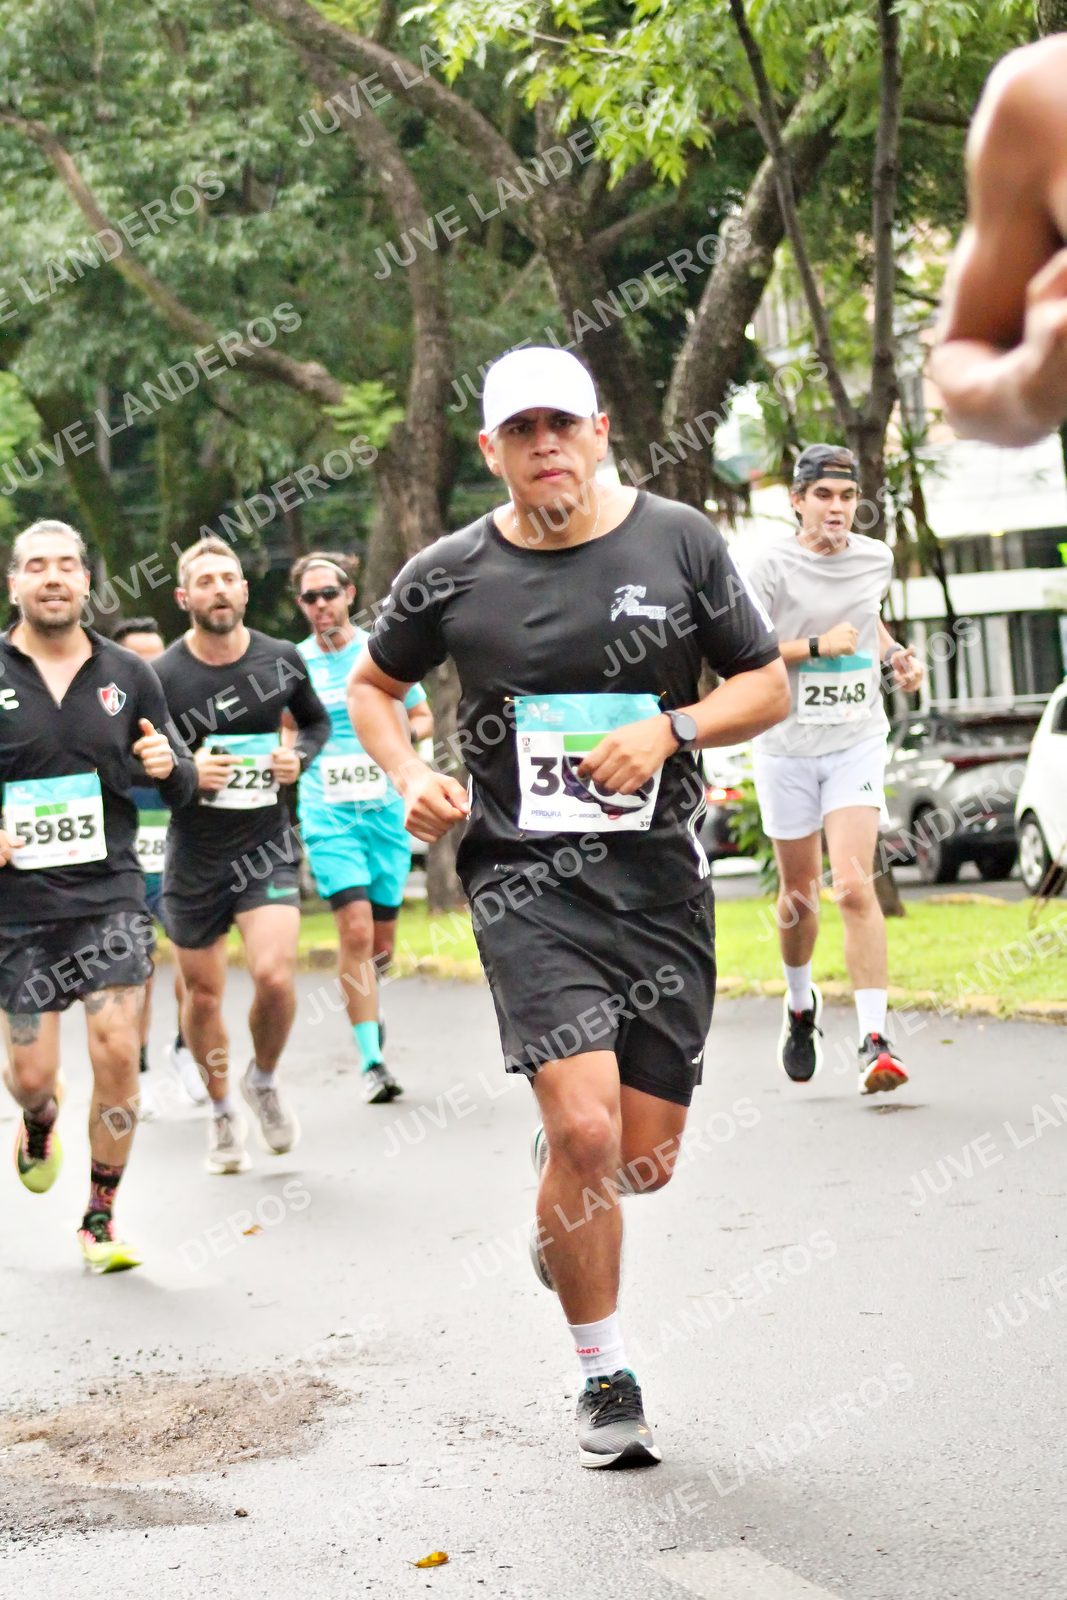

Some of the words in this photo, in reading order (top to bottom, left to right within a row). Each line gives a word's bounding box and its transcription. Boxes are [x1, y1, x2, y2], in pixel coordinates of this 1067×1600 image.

[804, 683, 866, 706] 2548
[227, 769, 275, 789] 229
[327, 764, 380, 785] 3495
[15, 814, 97, 845] 5983
